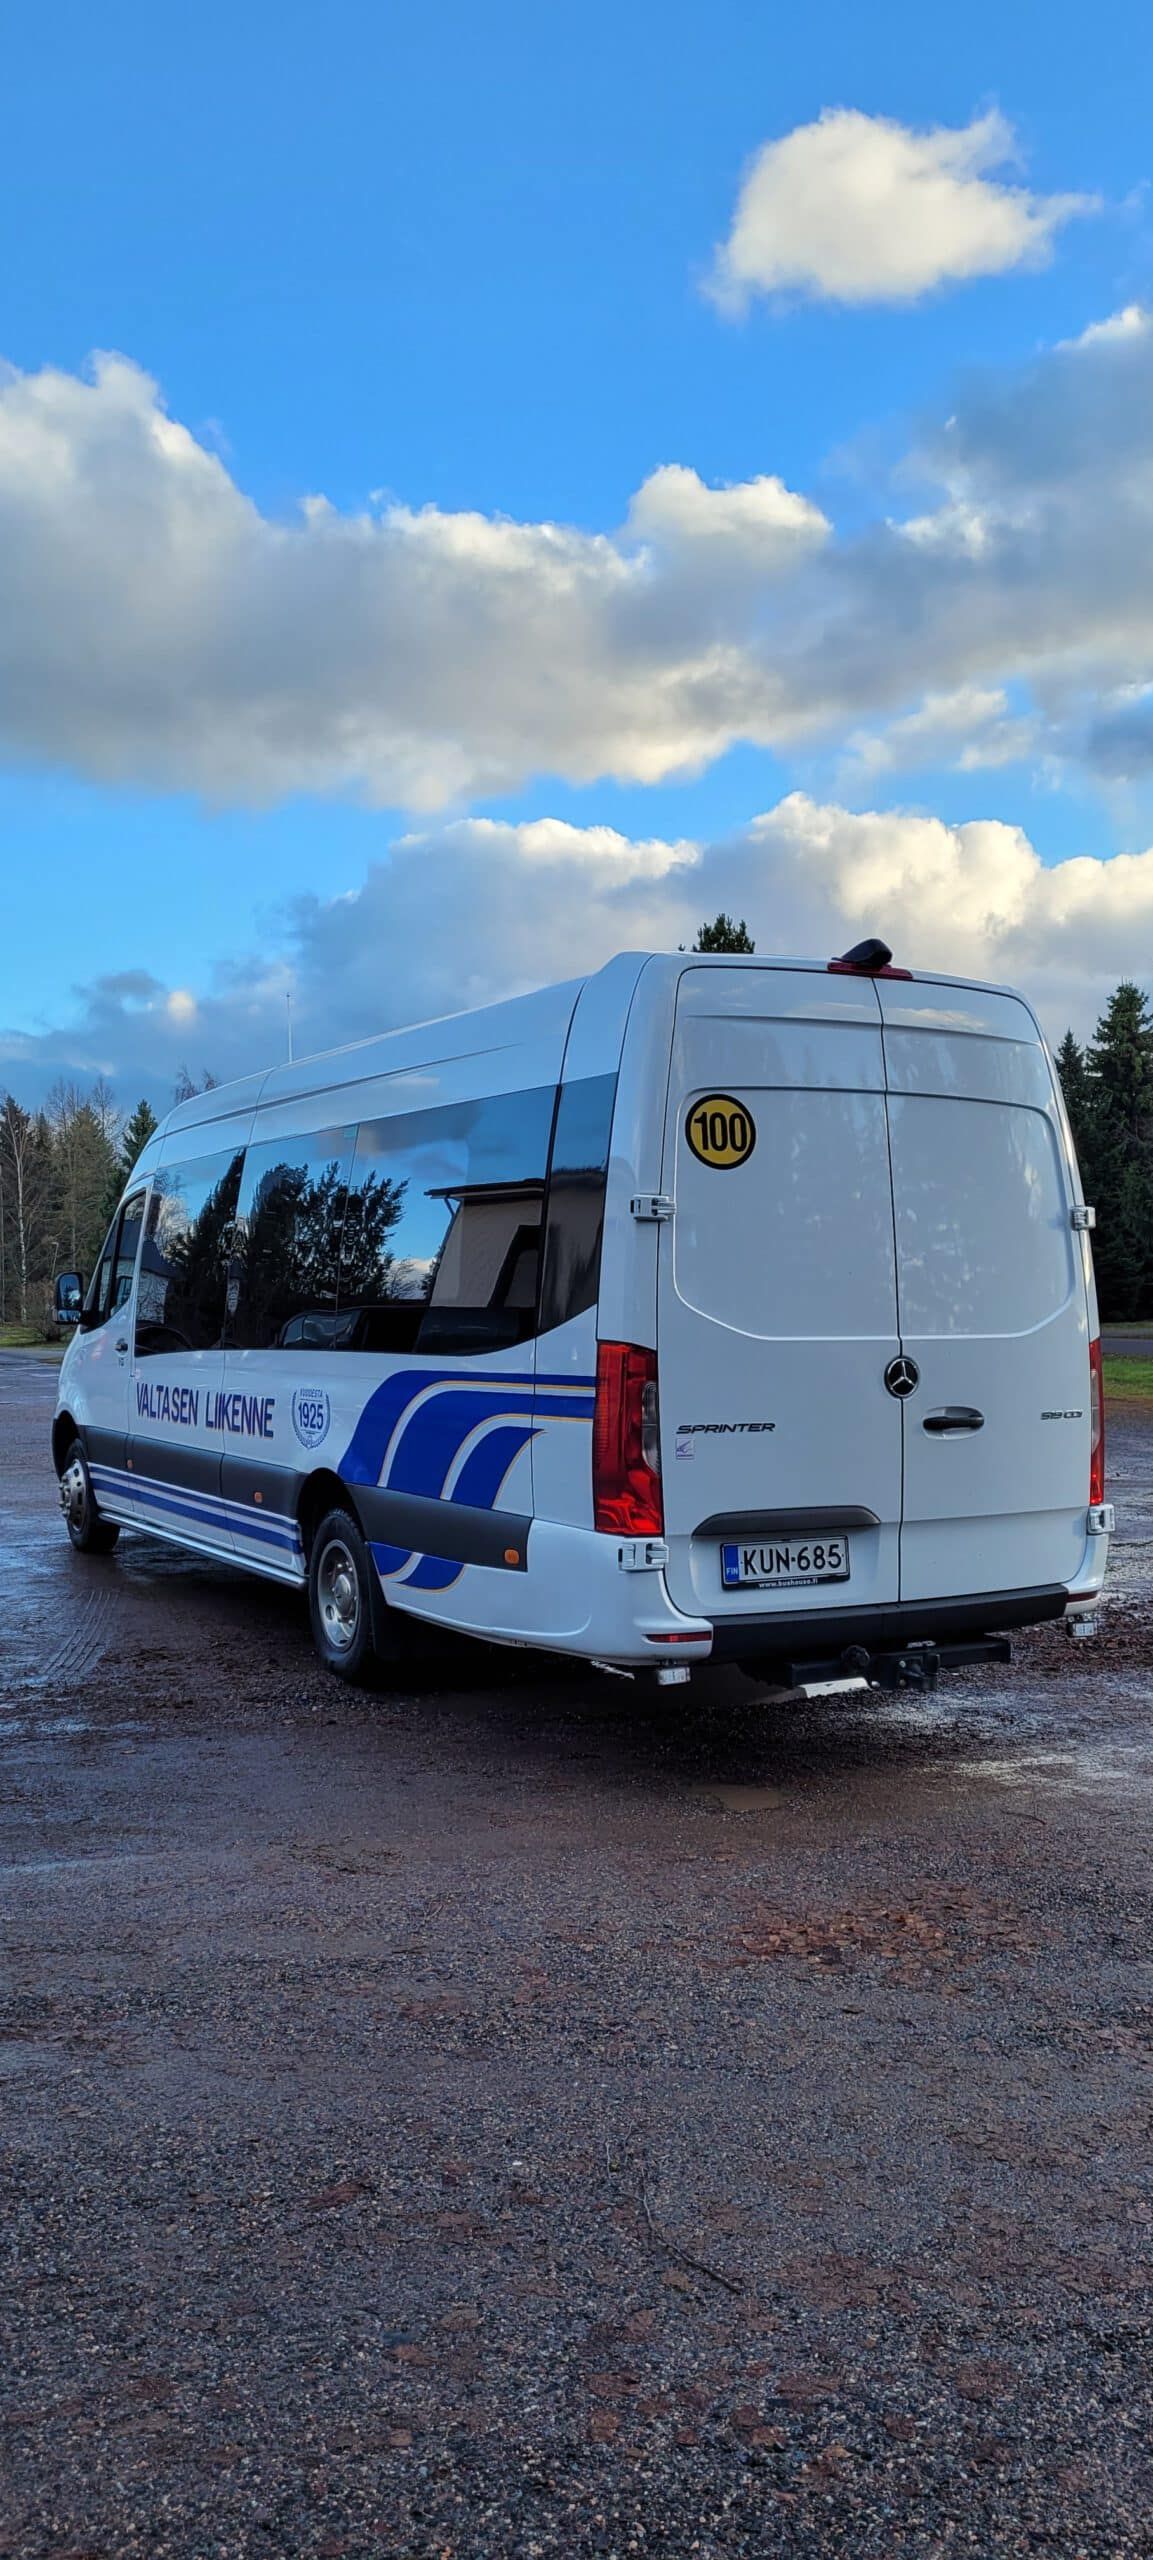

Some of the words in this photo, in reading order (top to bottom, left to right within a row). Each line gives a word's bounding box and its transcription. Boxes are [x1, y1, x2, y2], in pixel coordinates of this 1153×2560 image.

[693, 1111, 748, 1152] 100
[136, 1382, 199, 1427] VALTASEN
[205, 1391, 276, 1438] LIIKENNE
[298, 1402, 324, 1430] 1925
[675, 1422, 776, 1434] SPRINTER
[726, 1567, 739, 1576] FIN
[743, 1544, 842, 1576] KUN-685
